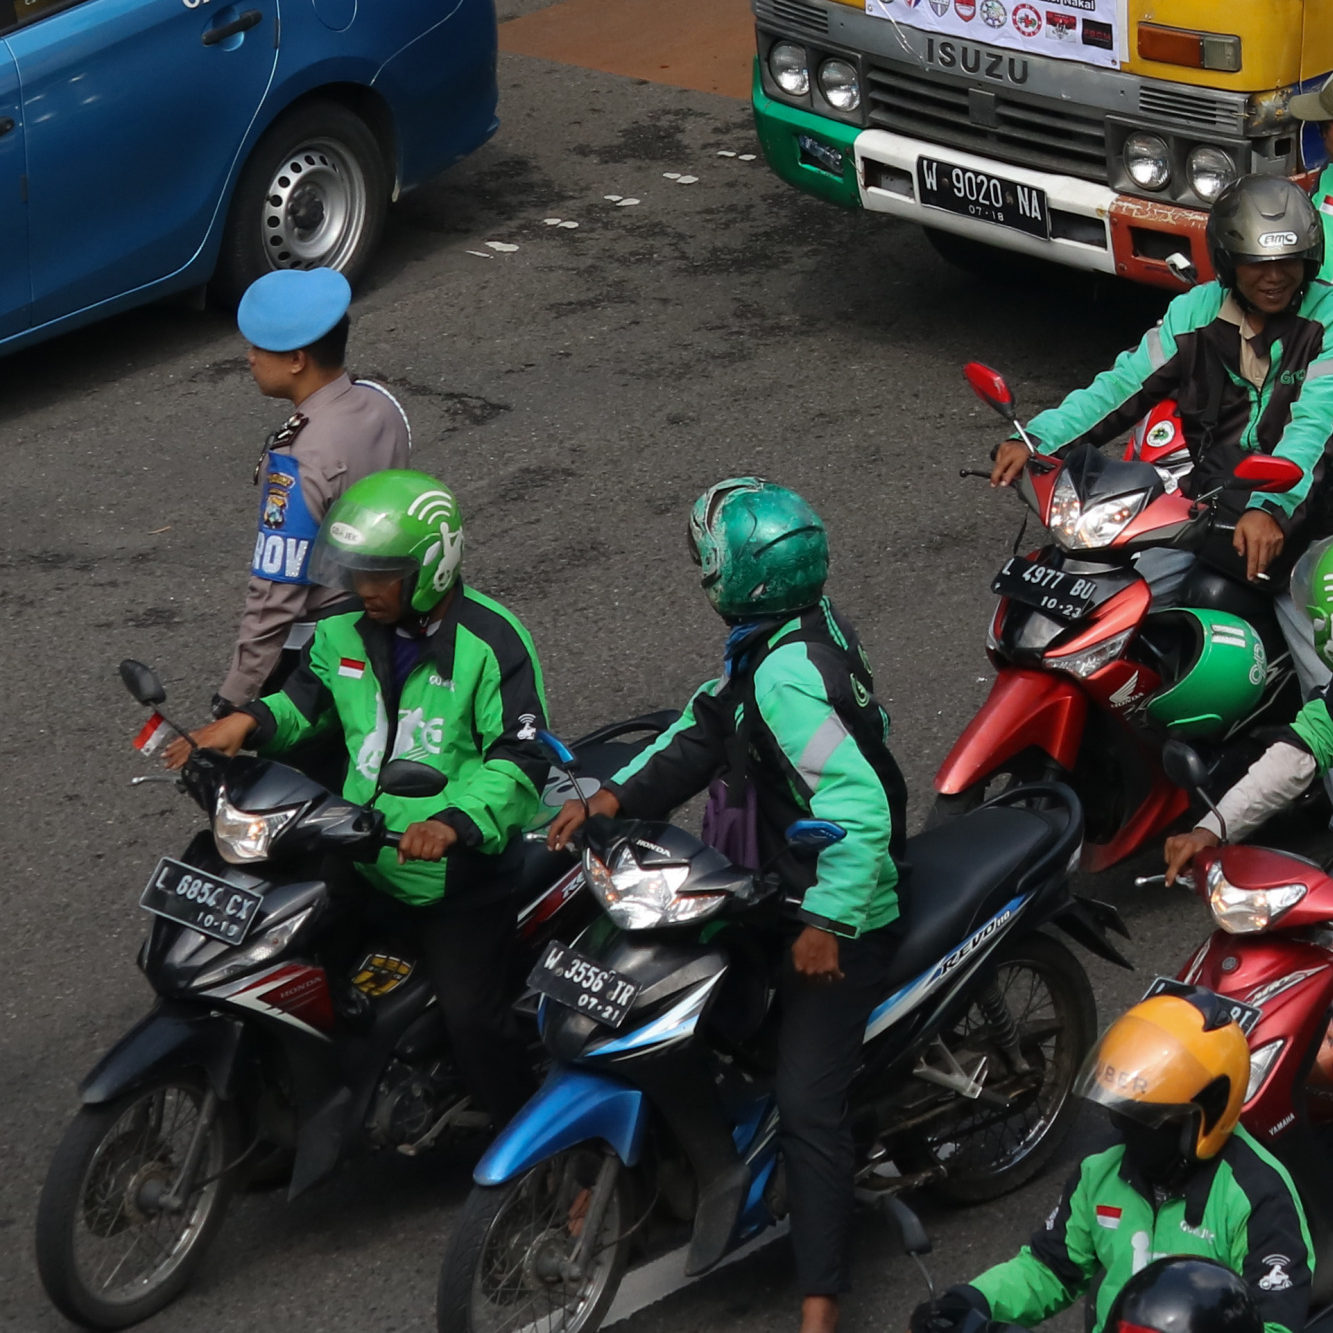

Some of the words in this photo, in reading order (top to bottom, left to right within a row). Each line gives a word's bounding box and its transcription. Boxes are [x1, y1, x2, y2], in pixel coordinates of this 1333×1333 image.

[926, 37, 1028, 85] ISUZU
[922, 159, 938, 193] W
[952, 168, 1003, 208] 9020
[1017, 183, 1042, 222] NA
[1001, 559, 1012, 576] L
[1022, 564, 1065, 590] 4977
[1069, 578, 1097, 601] BU
[636, 839, 672, 858] HONDA
[225, 895, 254, 921] CX
[940, 919, 996, 976] REVO
[995, 910, 1012, 928] 110
[280, 976, 322, 998] HONDA
[543, 948, 561, 970] W
[564, 959, 610, 991] 3556
[1268, 1113, 1296, 1136] YAMAHA
